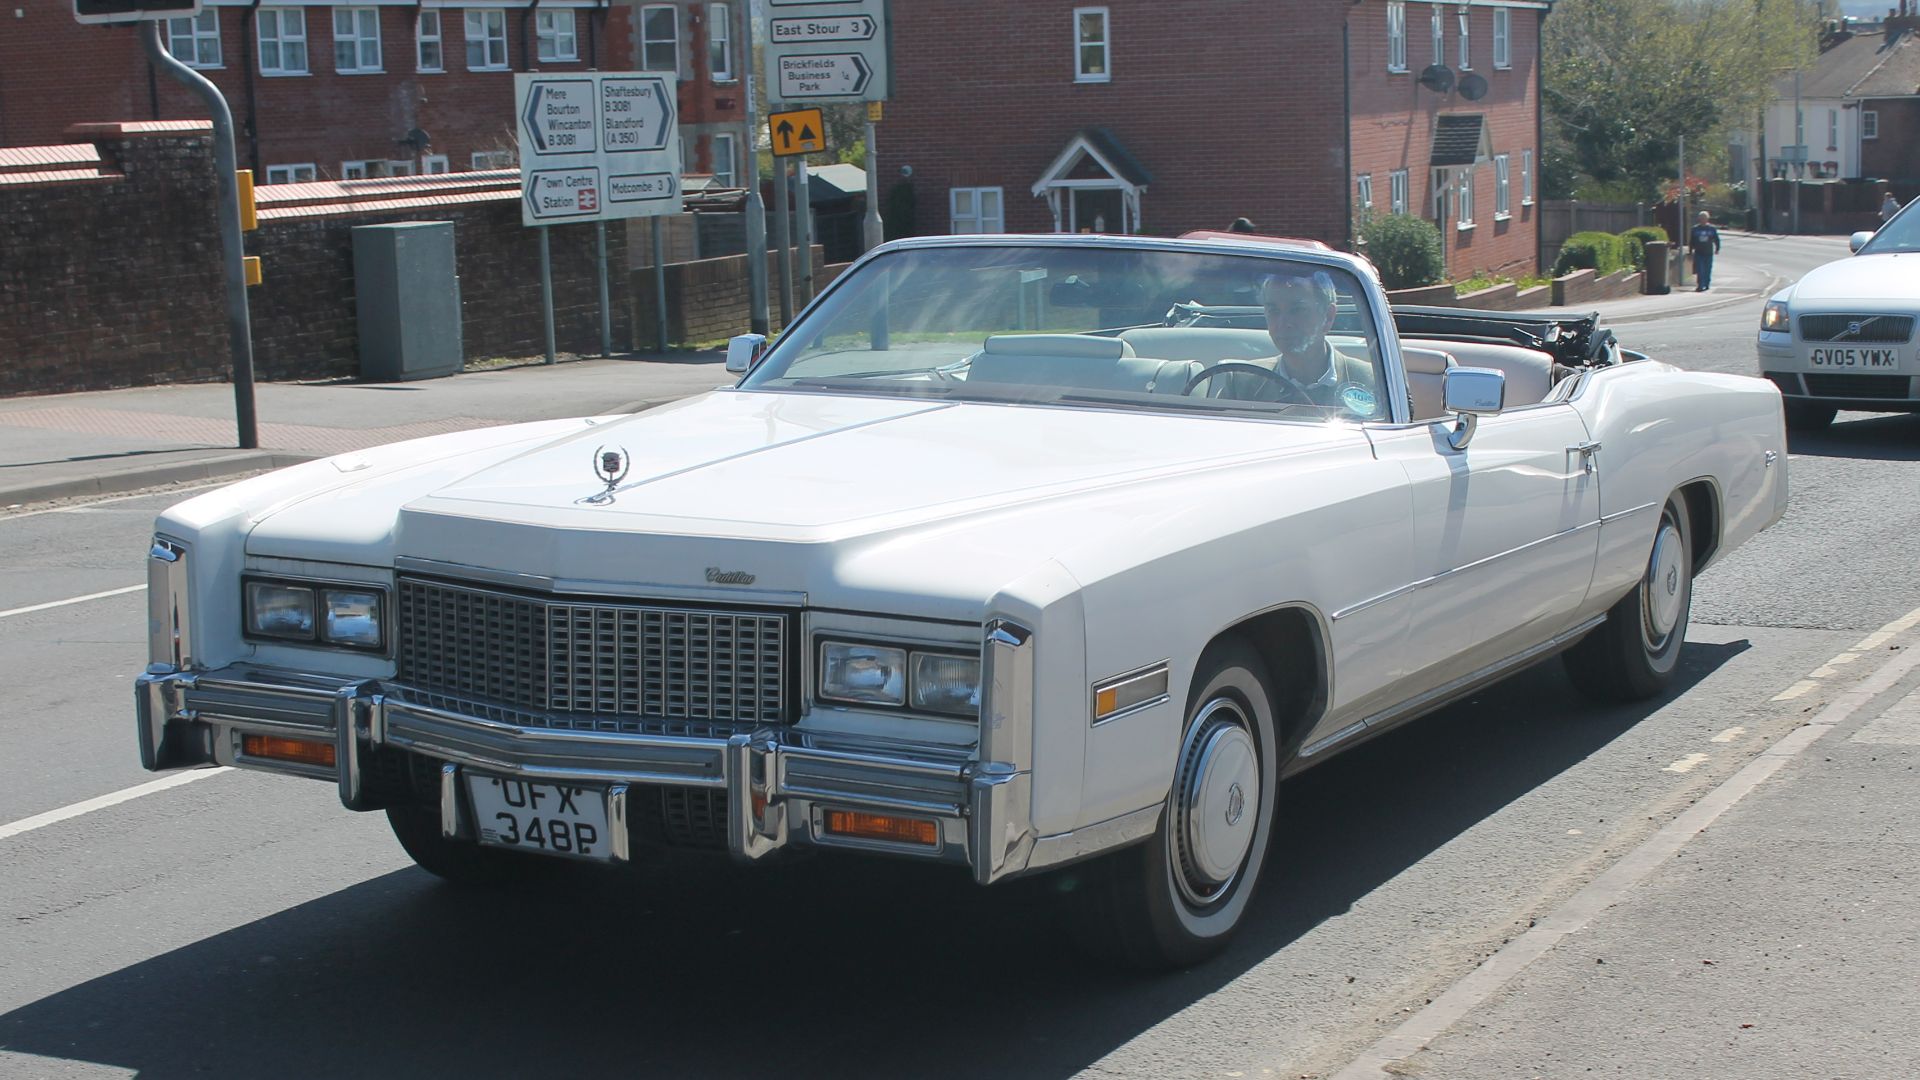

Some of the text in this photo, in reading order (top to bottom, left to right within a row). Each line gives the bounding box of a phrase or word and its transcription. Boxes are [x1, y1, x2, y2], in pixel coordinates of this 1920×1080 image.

[775, 22, 859, 36] East Stour 3
[783, 59, 835, 70] Brickfields
[788, 71, 831, 81] Business
[605, 85, 652, 99] Shaftesbury
[799, 82, 820, 92] Park
[546, 88, 567, 100] Mere
[547, 103, 581, 115] Bourton
[548, 119, 592, 131] Wincanton
[606, 117, 644, 129] Blandford
[566, 175, 593, 187] Centre
[658, 179, 664, 191] 3
[543, 196, 574, 209] Station
[1814, 349, 1893, 366] GV05 YWX
[496, 812, 598, 854] 348P
